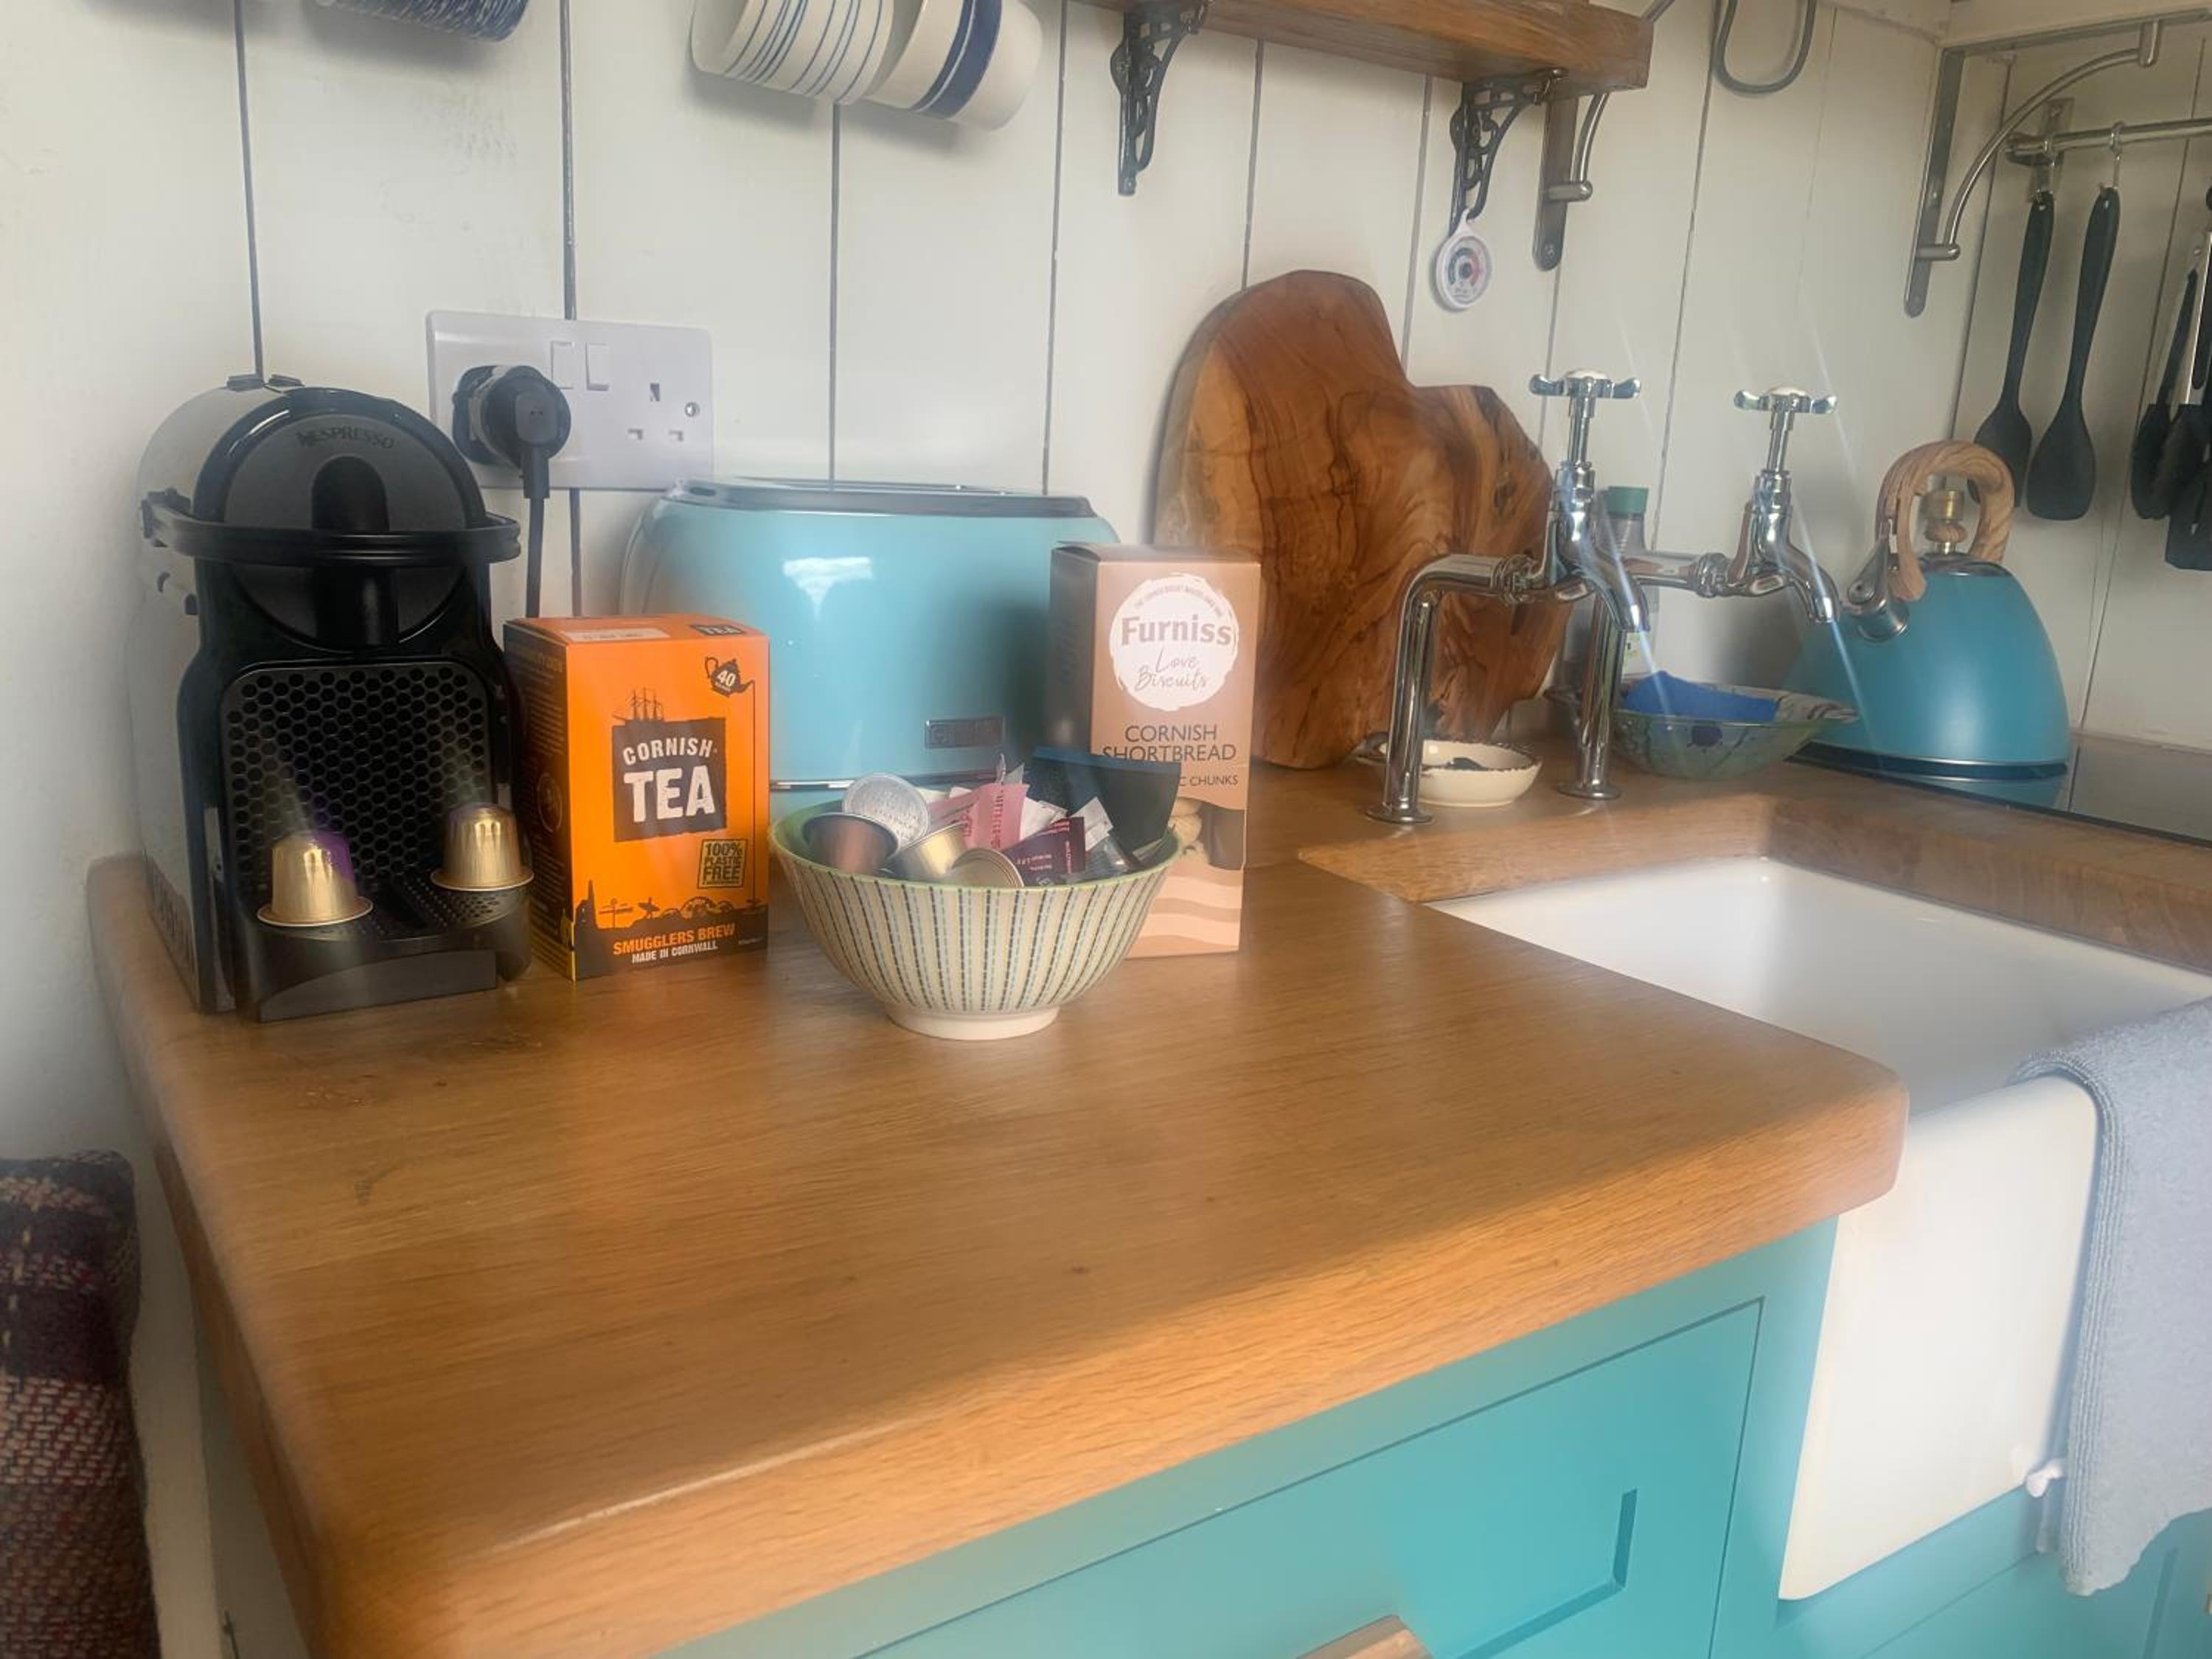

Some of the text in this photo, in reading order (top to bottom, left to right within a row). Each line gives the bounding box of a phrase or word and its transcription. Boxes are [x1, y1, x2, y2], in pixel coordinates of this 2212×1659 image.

[295, 425, 396, 449] NESPRESSO
[1121, 613, 1232, 647] Furniss
[1155, 647, 1199, 674] Love
[717, 669, 737, 686] 40
[1133, 664, 1208, 692] Biscuits
[1124, 723, 1217, 742] CORNISH
[622, 737, 713, 765] CORNISH
[1102, 743, 1237, 762] SHORTBREAD
[1189, 774, 1239, 787] CHUNKS
[623, 765, 716, 823] TEA
[705, 843, 742, 855] 100%
[703, 866, 740, 880] FREE
[613, 923, 736, 956] SMUGGLERS BREW
[631, 940, 718, 964] MADE IN CORNWALL
